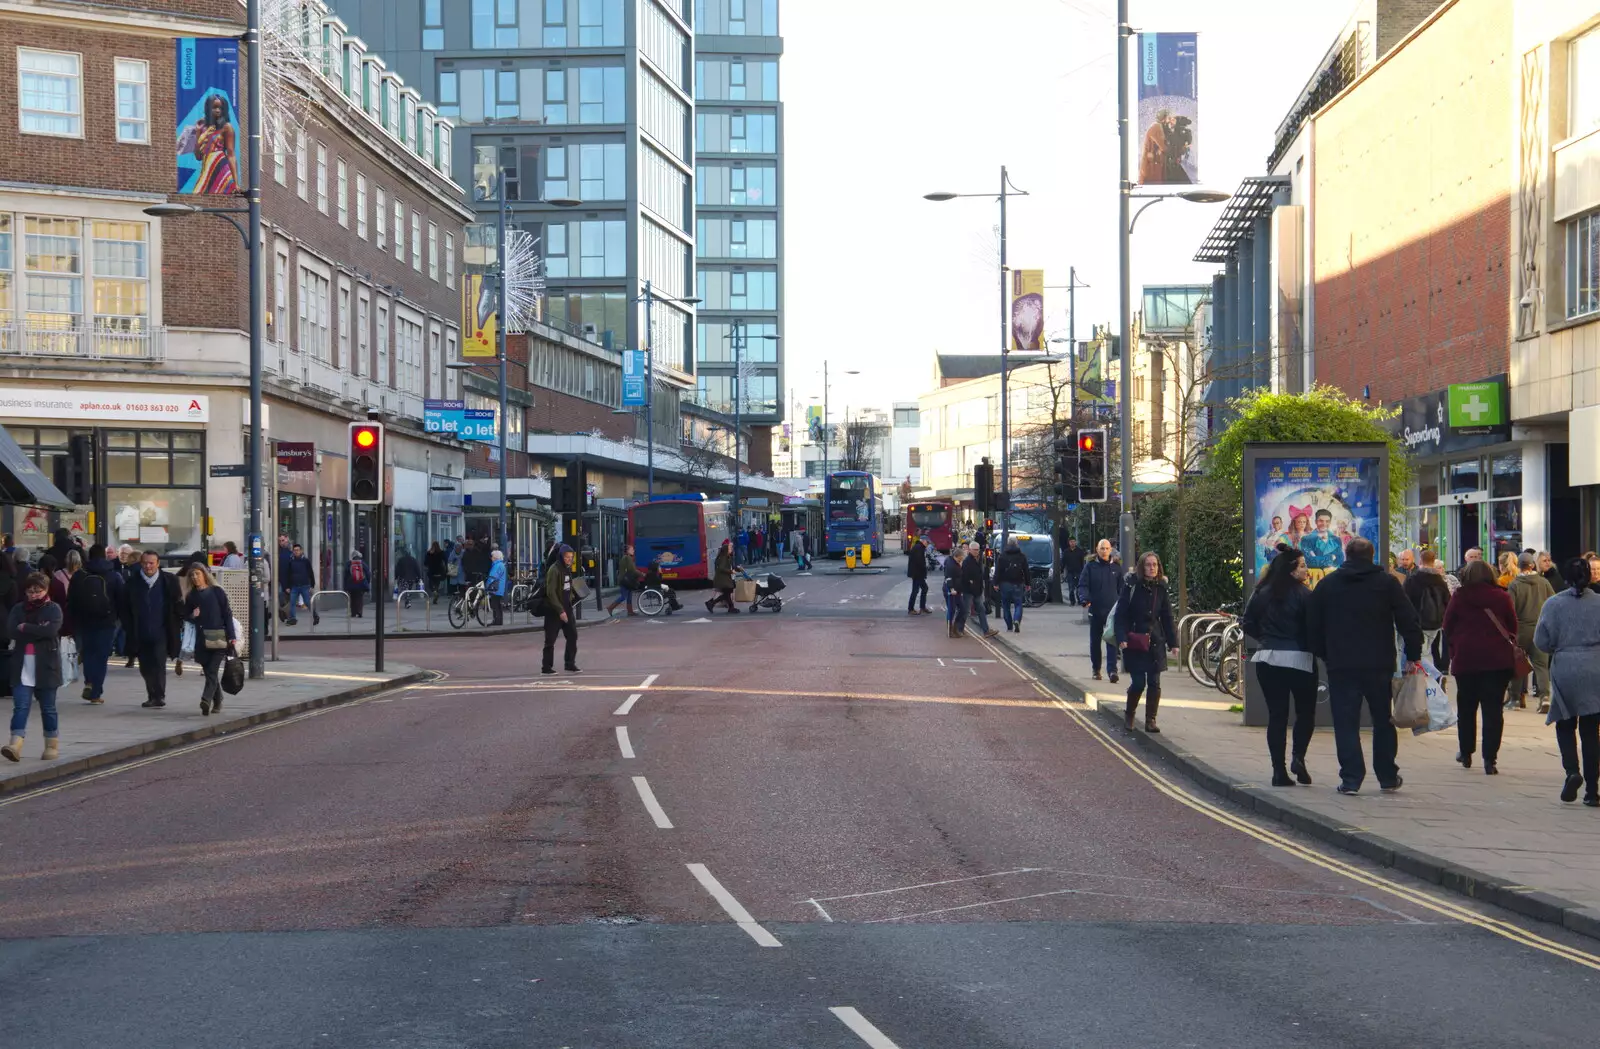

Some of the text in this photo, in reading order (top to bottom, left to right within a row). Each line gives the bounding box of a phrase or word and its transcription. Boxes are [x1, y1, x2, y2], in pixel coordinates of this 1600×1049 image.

[184, 48, 192, 86] Shopping
[34, 400, 73, 408] insurance
[80, 402, 122, 411] aplan.co.uk
[126, 404, 148, 412] 01603
[150, 404, 163, 412] 863
[166, 404, 179, 412] 020
[426, 419, 458, 432] to let
[460, 424, 494, 436] o let
[1404, 424, 1440, 448] Superdrug
[276, 450, 312, 458] ainsbury's
